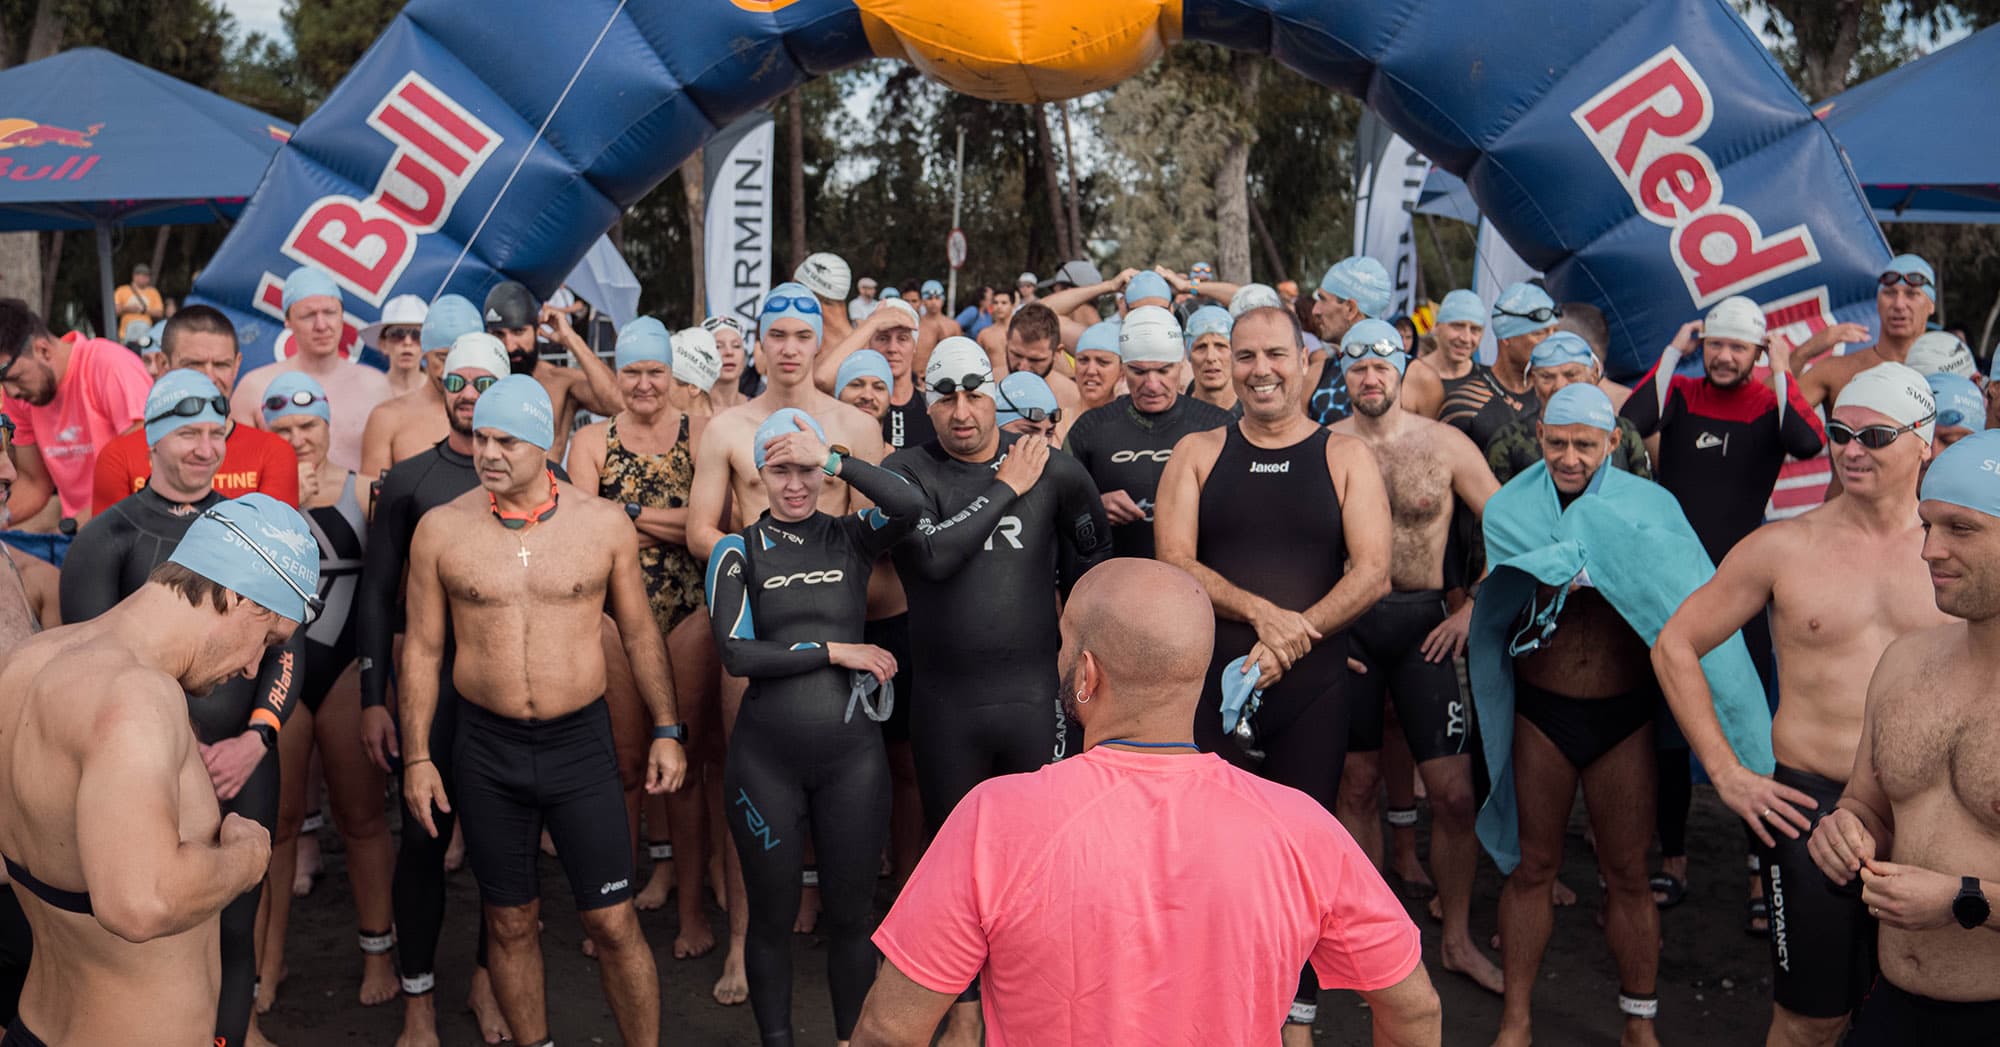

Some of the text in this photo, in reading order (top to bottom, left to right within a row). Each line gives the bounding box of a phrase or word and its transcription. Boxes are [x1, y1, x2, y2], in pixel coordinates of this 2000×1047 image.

[280, 72, 504, 309] Bull
[1571, 44, 1821, 310] Red
[734, 159, 763, 342] ARMIN
[1938, 358, 1965, 373] SWIM
[1905, 386, 1934, 413] SWIM
[1111, 448, 1174, 463] orc
[1249, 460, 1290, 473] Jaked
[763, 569, 844, 589] orca
[1446, 700, 1463, 737] TYR
[1770, 864, 1790, 972] BUOYANCY
